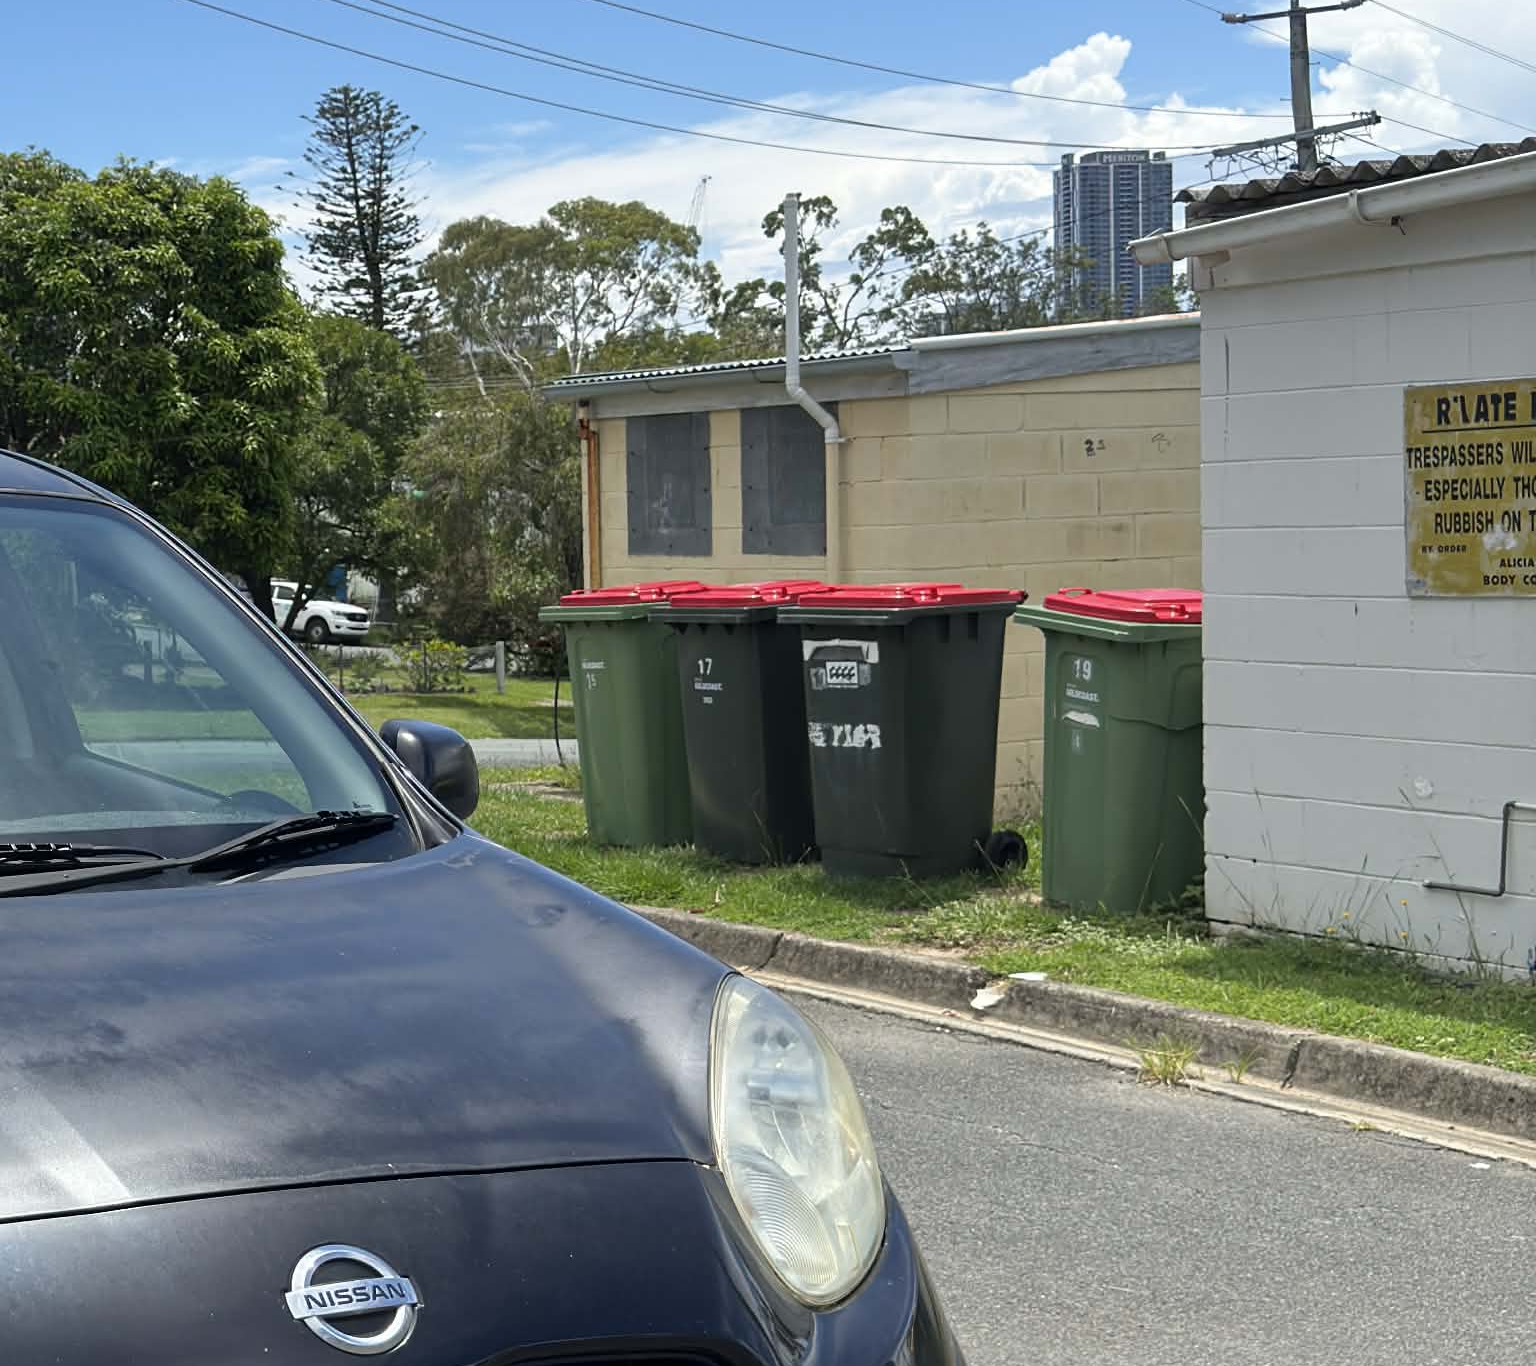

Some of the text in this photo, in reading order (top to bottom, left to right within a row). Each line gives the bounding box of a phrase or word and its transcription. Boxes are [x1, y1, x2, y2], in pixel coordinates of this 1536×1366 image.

[1406, 442, 1503, 469] TRESPASSERS
[1424, 475, 1505, 501] ESPECIALLY
[1434, 509, 1494, 534] RUBBISH
[1501, 509, 1521, 533] ON
[1438, 544, 1467, 554] ORDER
[1499, 557, 1535, 568] ALICIA
[1483, 575, 1516, 586] BODY
[697, 658, 713, 676] 17
[1073, 658, 1093, 681] 19
[304, 1283, 405, 1310] NISSAN
